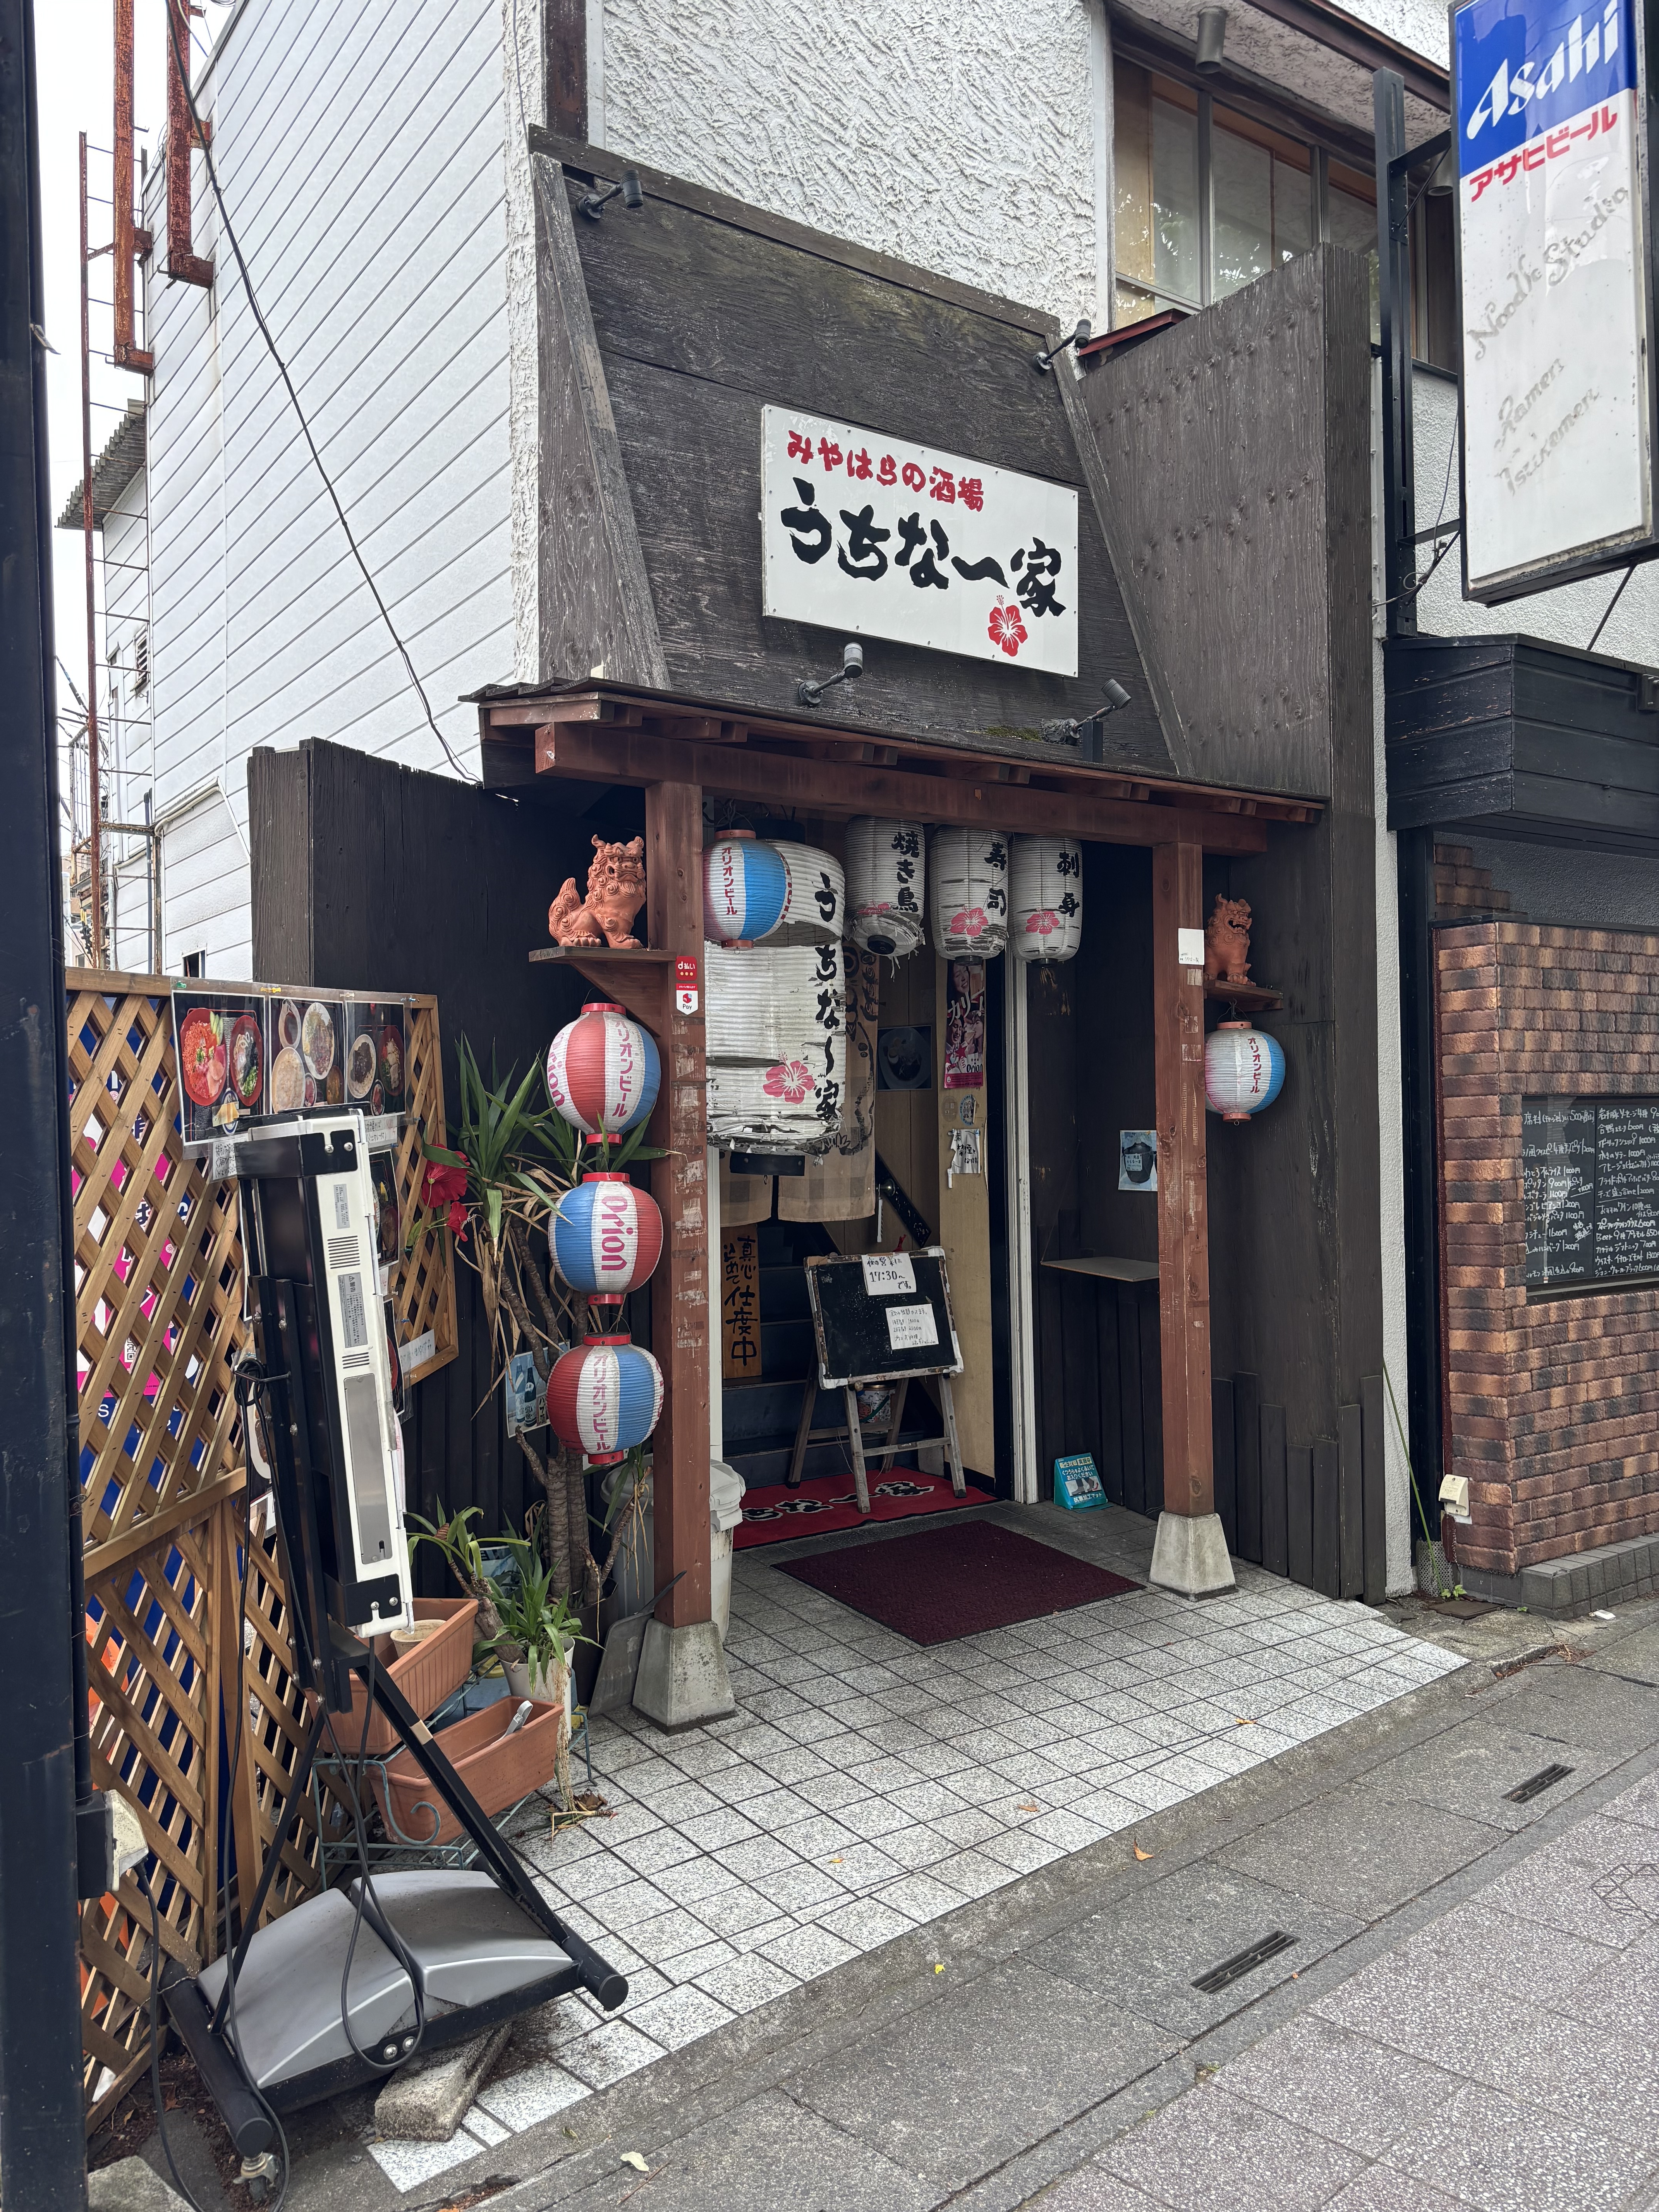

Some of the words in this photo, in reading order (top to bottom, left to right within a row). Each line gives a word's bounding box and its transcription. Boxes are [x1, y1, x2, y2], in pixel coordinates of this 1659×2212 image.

[1467, 0, 1618, 139] Asahi
[1470, 106, 1618, 202] アサヒビール
[1494, 359, 1564, 452] Ramen
[787, 430, 984, 512] みやはらの酒場
[721, 847, 738, 915] オリオンビール
[891, 831, 919, 912] 焼き鳥
[985, 842, 1007, 916] 寿司
[1057, 852, 1080, 917] 刺身
[678, 961, 695, 970] d払い
[612, 1021, 633, 1117] オリオンビール
[966, 1062, 983, 1073] Orion
[1247, 1037, 1262, 1093] オリオンビール
[1639, 1136, 1656, 1144] 1000円
[1548, 1178, 1567, 1188] 900円
[1563, 1166, 1580, 1176] 1000円
[601, 1195, 634, 1271] Orion
[1549, 1228, 1567, 1237] 1600円
[1562, 1199, 1580, 1209] 1200円
[1566, 1211, 1584, 1219] 1100円
[737, 1235, 756, 1279] 真心
[1596, 1233, 1613, 1242] Beer
[593, 1356, 611, 1451] オリオンビール
